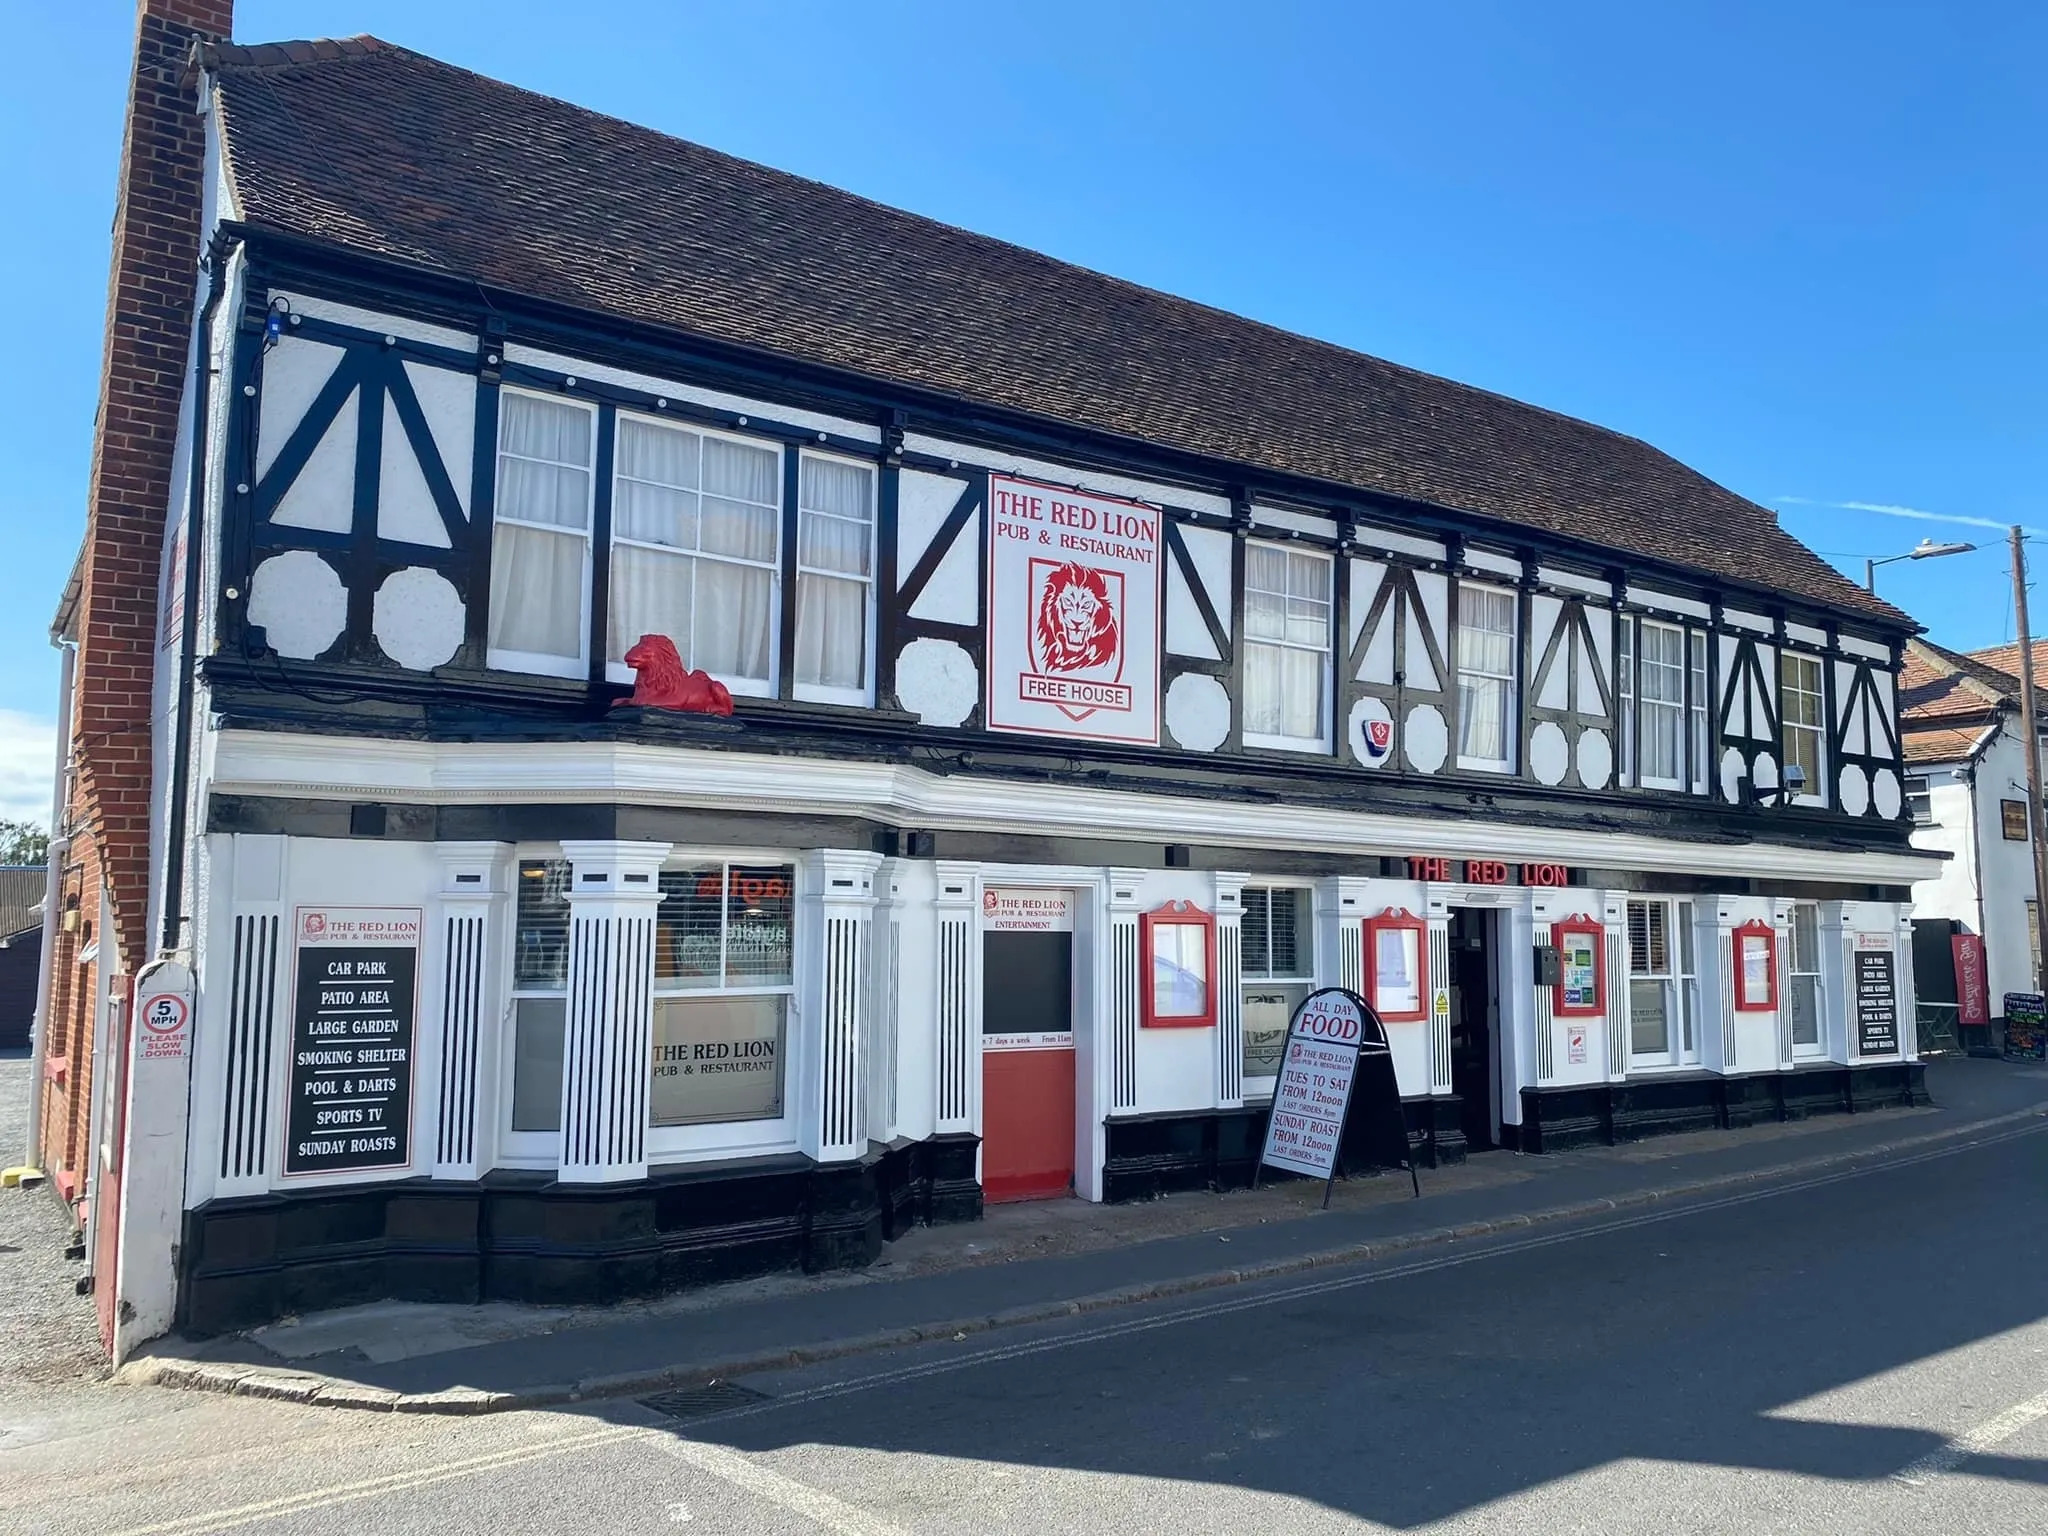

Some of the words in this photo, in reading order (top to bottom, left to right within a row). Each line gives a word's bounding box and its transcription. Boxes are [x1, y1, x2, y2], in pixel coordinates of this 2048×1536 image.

[996, 490, 1043, 521] THE
[1051, 499, 1097, 531] RED
[1102, 511, 1155, 544] LION
[997, 521, 1030, 542] PUB
[1038, 530, 1051, 545] &
[1060, 534, 1154, 564] RESTAURANT
[1028, 680, 1067, 699] FREE
[1072, 684, 1124, 705] HOUSE
[1408, 856, 1450, 881] THE
[1465, 860, 1508, 884] RED
[1522, 863, 1568, 887] LION
[1001, 899, 1020, 908] THE
[1022, 900, 1042, 908] RED
[1044, 900, 1066, 909] LION
[330, 922, 355, 932] THE
[358, 922, 384, 932] RED
[388, 922, 417, 932] LION
[995, 920, 1050, 928] ENTERTAINMENT
[328, 962, 351, 975] CAR
[356, 962, 386, 975] PARK
[321, 991, 354, 1004] PATIO
[360, 991, 390, 1004] AREA
[158, 1000, 171, 1015] 5
[1313, 1002, 1329, 1012] ALL
[1334, 1004, 1354, 1016] DAY
[151, 1016, 177, 1024] MPH
[308, 1020, 347, 1035] LARGE
[352, 1019, 399, 1034] GARDEN
[1299, 1013, 1358, 1040] FOOD
[141, 1034, 187, 1042] PLEASE
[146, 1050, 182, 1058] DOWN
[298, 1050, 352, 1066] SMOKING
[357, 1048, 406, 1062] SHELTER
[653, 1044, 688, 1062] THE
[693, 1043, 728, 1060] RED
[733, 1040, 775, 1058] LION
[1304, 1050, 1317, 1059] THE
[1318, 1051, 1334, 1060] RED
[1336, 1054, 1353, 1064] LION
[654, 1066, 678, 1077] PUB
[684, 1064, 694, 1075] &
[700, 1061, 774, 1074] RESTAURANT
[304, 1081, 338, 1095] POOL
[343, 1080, 353, 1093] &
[358, 1078, 396, 1092] DARTS
[1286, 1070, 1309, 1085] TUES
[1313, 1074, 1326, 1088] TO
[1330, 1078, 1348, 1092] SAT
[1282, 1084, 1308, 1100] FROM
[1312, 1090, 1343, 1106] 12noon
[1283, 1100, 1296, 1110] LAST
[1300, 1104, 1322, 1115] ORDERS
[316, 1109, 363, 1124] SPORTS
[368, 1108, 382, 1121] TV
[1274, 1114, 1308, 1131] SUNDAY
[1310, 1121, 1340, 1138] ROAST
[298, 1140, 346, 1156] SUNDAY
[350, 1136, 396, 1152] ROASTS
[1274, 1129, 1298, 1144] FROM
[1302, 1136, 1332, 1152] 12noon
[1274, 1145, 1287, 1154] LAST
[1289, 1148, 1312, 1160] ORDERS
